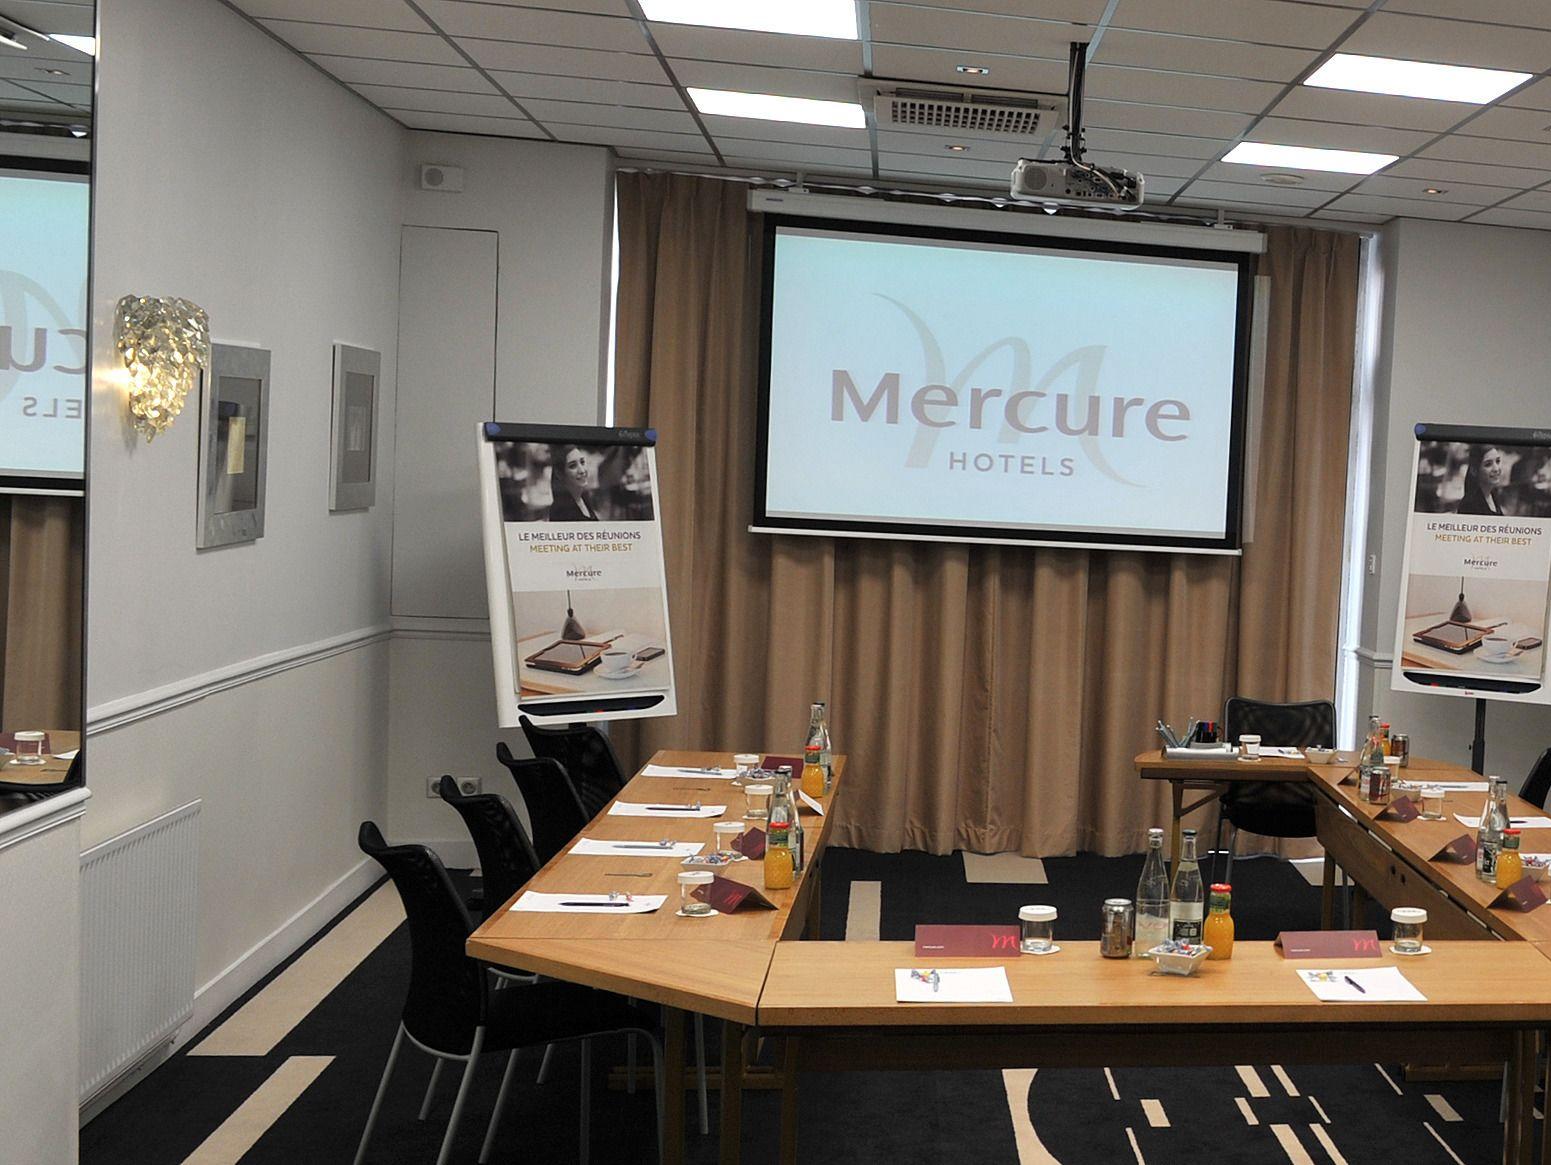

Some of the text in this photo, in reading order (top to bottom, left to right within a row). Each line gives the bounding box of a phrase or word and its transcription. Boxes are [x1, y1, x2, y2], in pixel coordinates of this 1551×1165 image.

[830, 369, 1191, 442] Mercure
[949, 451, 1075, 477] HOTELS
[518, 528, 641, 541] LE MEILLEUR DES RÉUNIONS
[1438, 523, 1478, 532] MEILLEUR
[1480, 525, 1497, 533] DES
[1499, 524, 1542, 535] RÉUNIONS
[1435, 534, 1532, 546] MEETING AT THEIR BEST
[529, 543, 632, 553] MEETING AT THEIR BEST
[1463, 558, 1498, 567] Mercure
